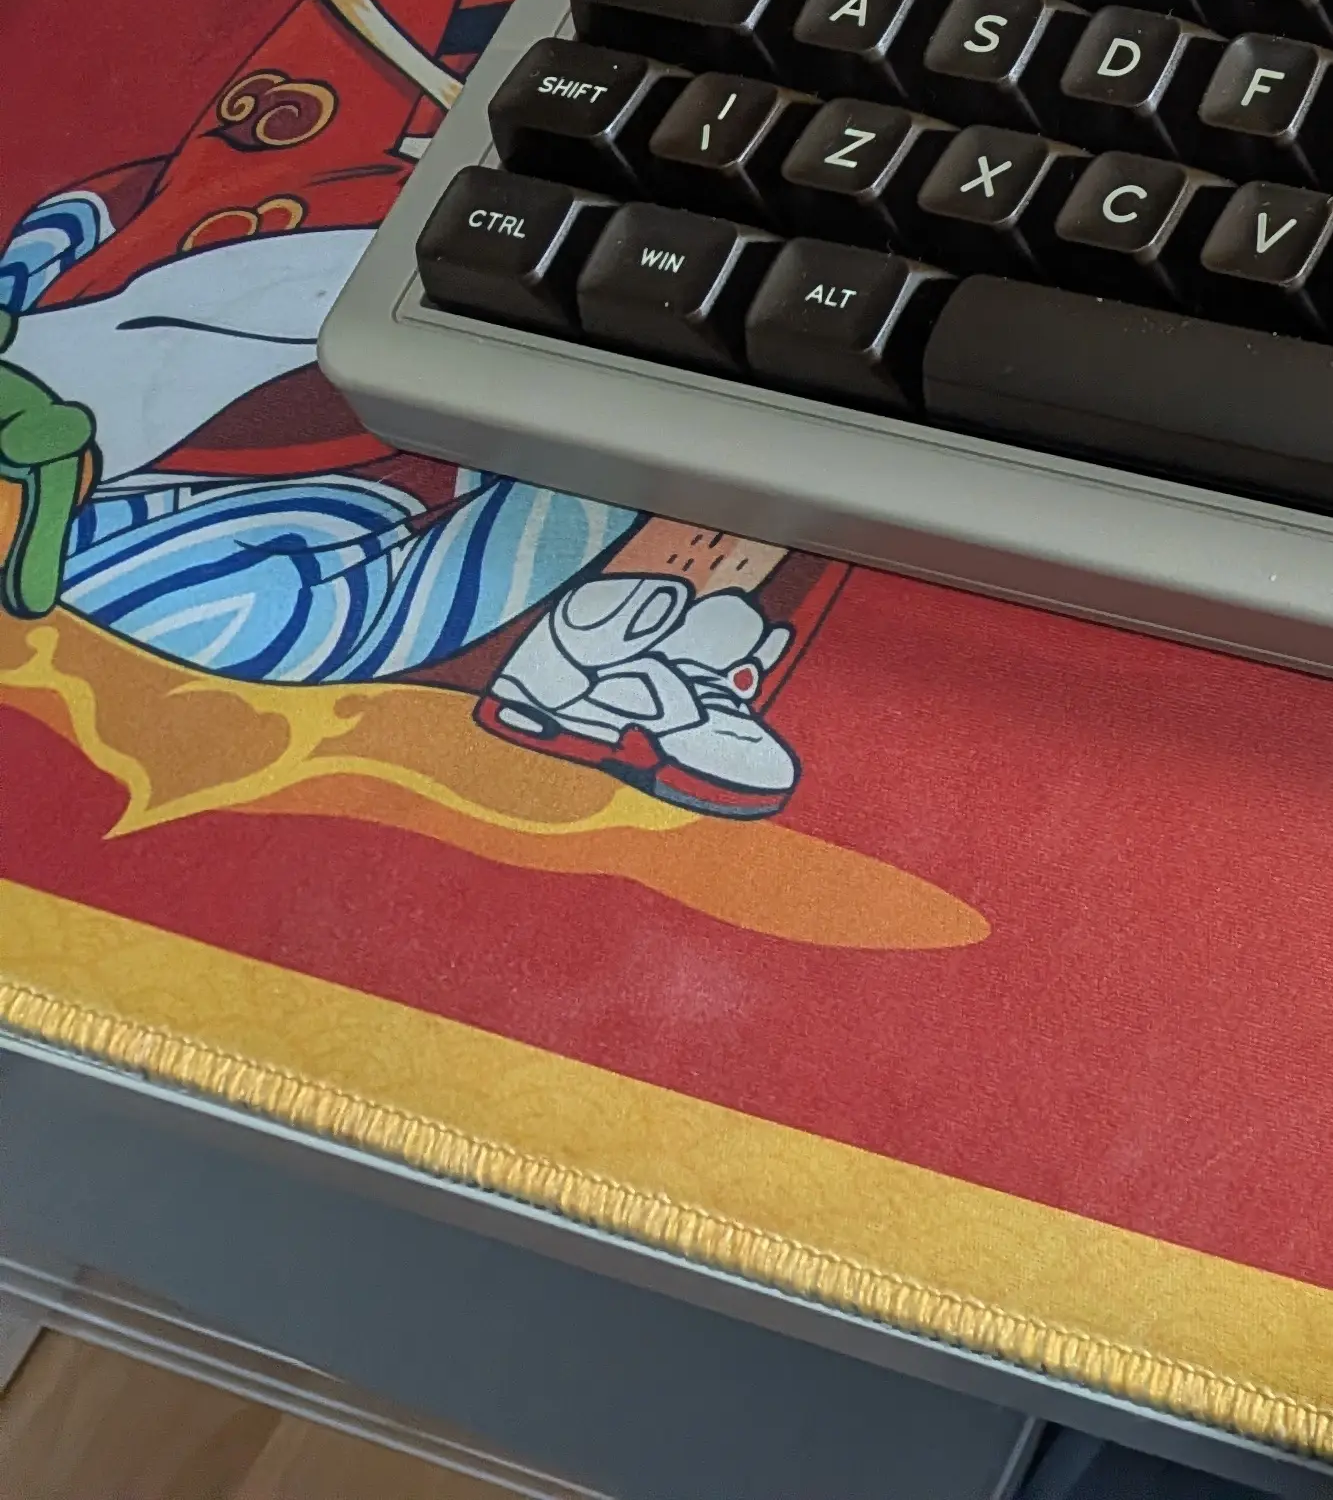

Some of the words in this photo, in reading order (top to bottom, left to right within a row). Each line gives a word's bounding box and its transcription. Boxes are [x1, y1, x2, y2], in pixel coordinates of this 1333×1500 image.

[963, 14, 1008, 53] S
[1097, 37, 1141, 77] D
[538, 76, 608, 104] SHIFT
[1240, 67, 1285, 106] F
[824, 128, 876, 169] Z
[960, 155, 1013, 198] X
[1102, 184, 1148, 223] C
[468, 209, 526, 239] CTRL
[1256, 212, 1298, 254] V
[641, 247, 685, 273] WIN
[805, 284, 857, 309] ALT
